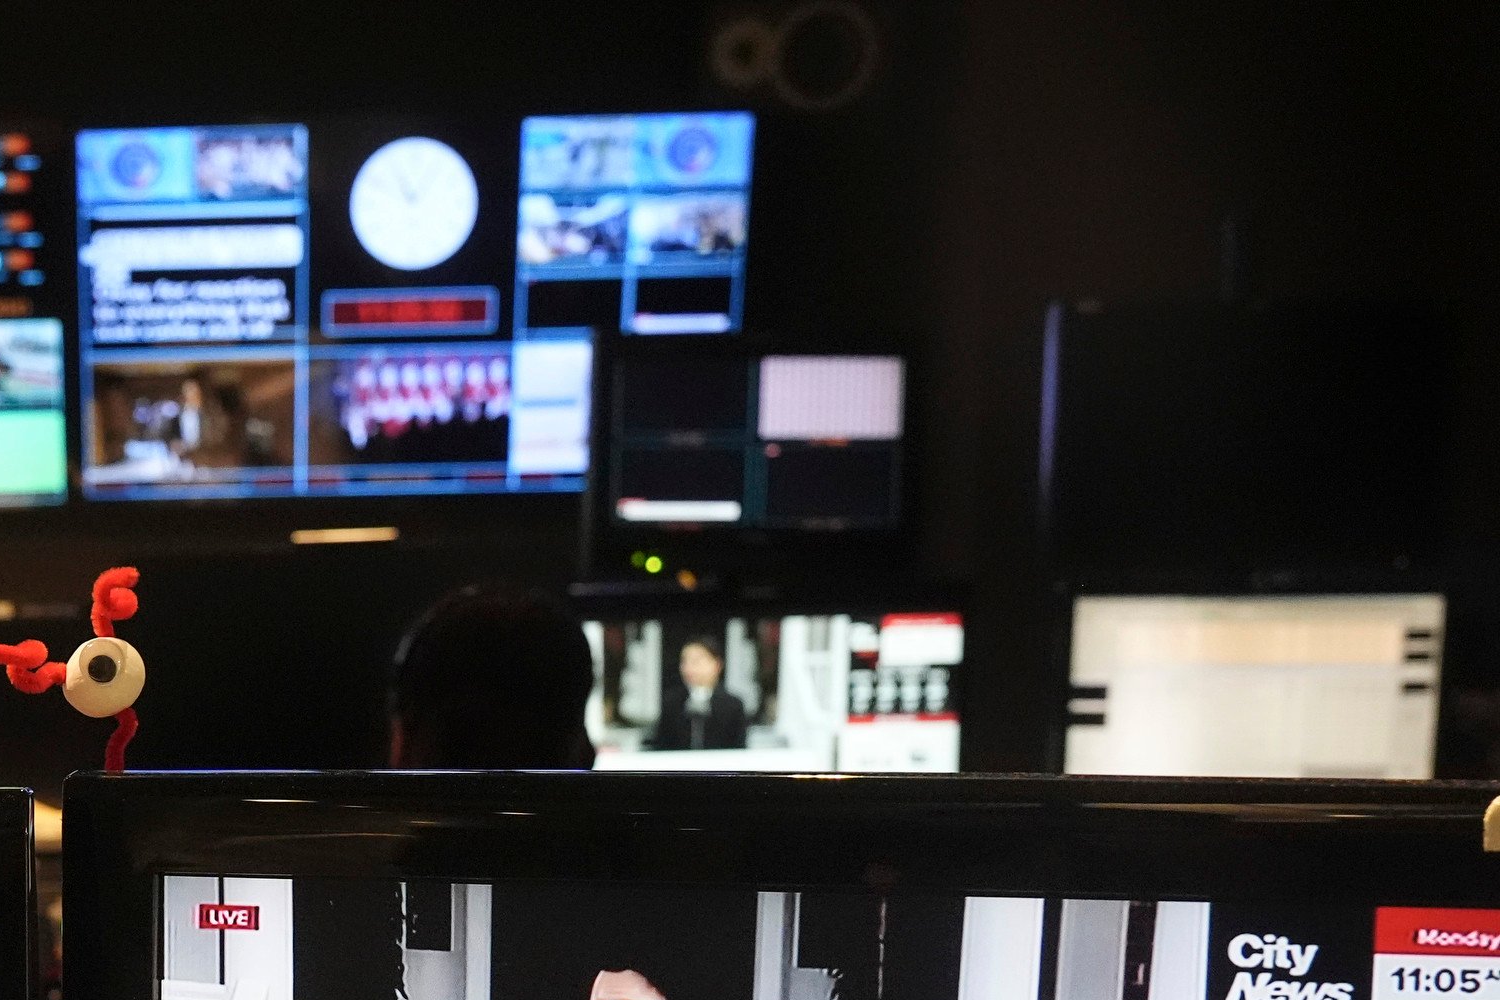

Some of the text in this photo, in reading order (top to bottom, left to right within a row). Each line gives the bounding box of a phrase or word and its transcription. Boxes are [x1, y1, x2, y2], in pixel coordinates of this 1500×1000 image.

[209, 910, 249, 926] LIVE
[1227, 933, 1319, 976] City
[1391, 966, 1481, 994] 11:05
